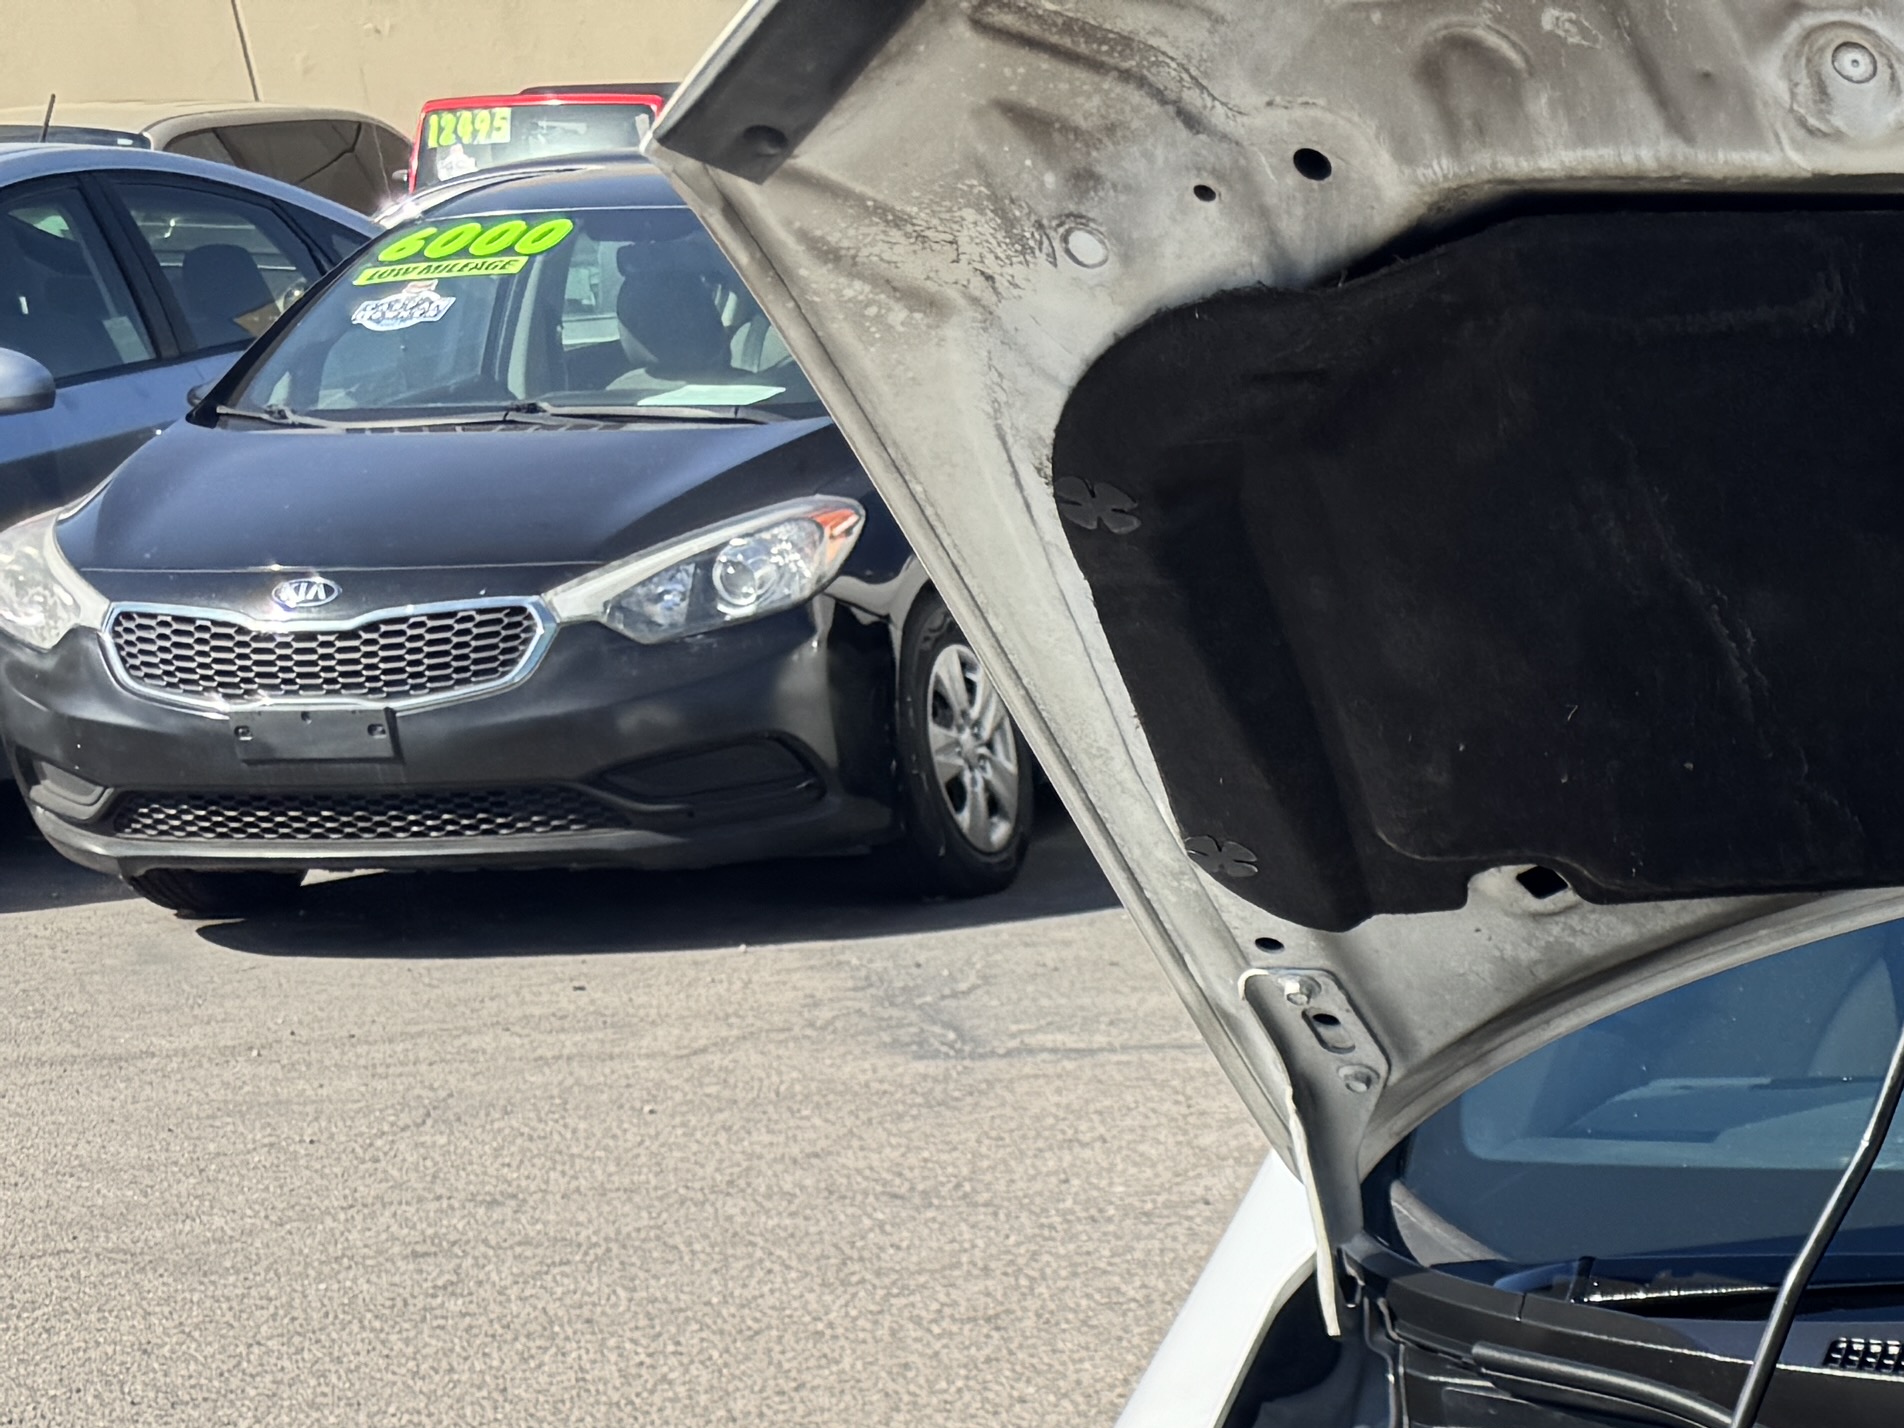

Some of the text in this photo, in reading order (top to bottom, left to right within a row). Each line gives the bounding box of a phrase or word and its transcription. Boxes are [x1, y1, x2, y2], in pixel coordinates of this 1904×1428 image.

[428, 107, 511, 148] 12495
[378, 218, 573, 262] 6000
[367, 258, 520, 281] LOW MILEAGE
